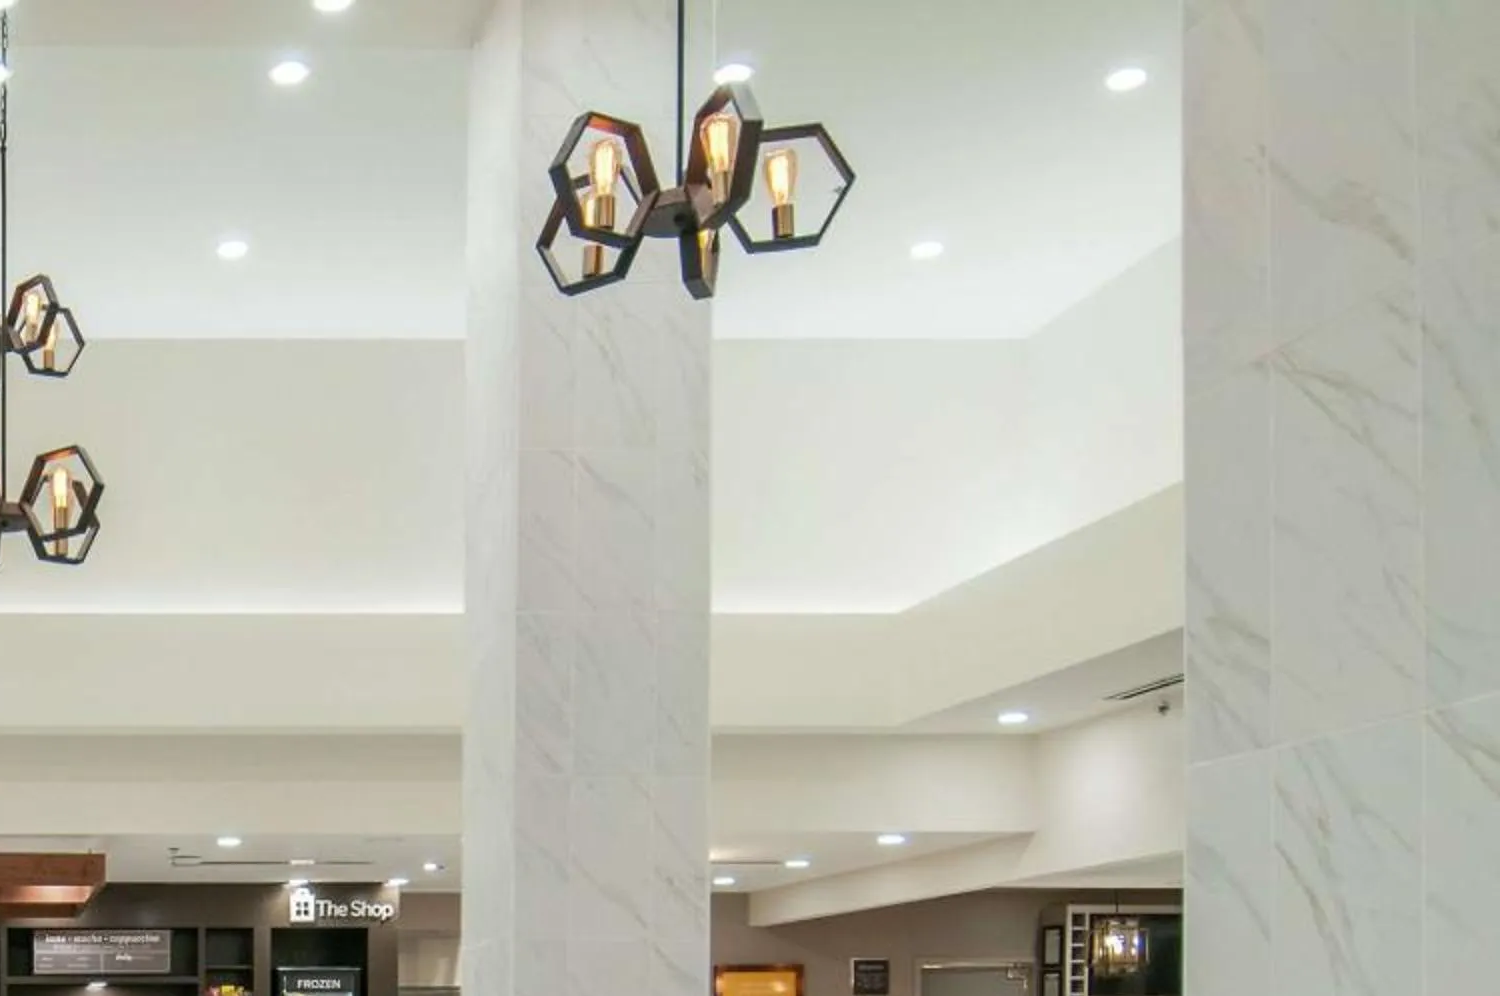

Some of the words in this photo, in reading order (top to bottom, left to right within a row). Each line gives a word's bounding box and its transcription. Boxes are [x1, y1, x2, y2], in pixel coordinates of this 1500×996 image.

[315, 900, 349, 917] The
[350, 900, 394, 921] Shop
[297, 979, 341, 989] FROZEN
